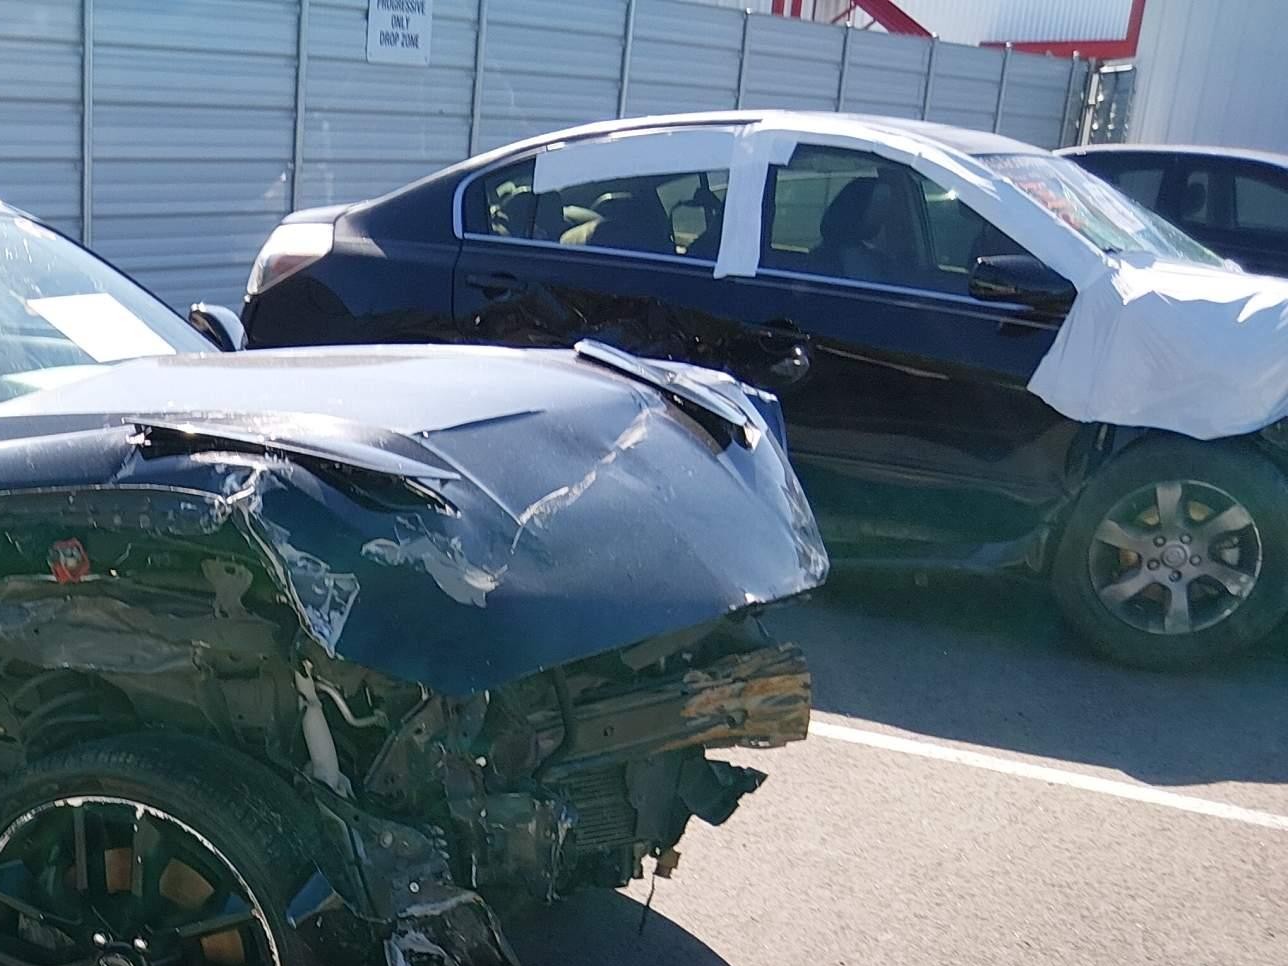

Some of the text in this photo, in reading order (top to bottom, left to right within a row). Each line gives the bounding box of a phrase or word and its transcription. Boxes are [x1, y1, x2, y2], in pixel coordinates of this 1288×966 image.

[391, 15, 410, 30] ONLY
[379, 31, 419, 49] DROP ZONE
